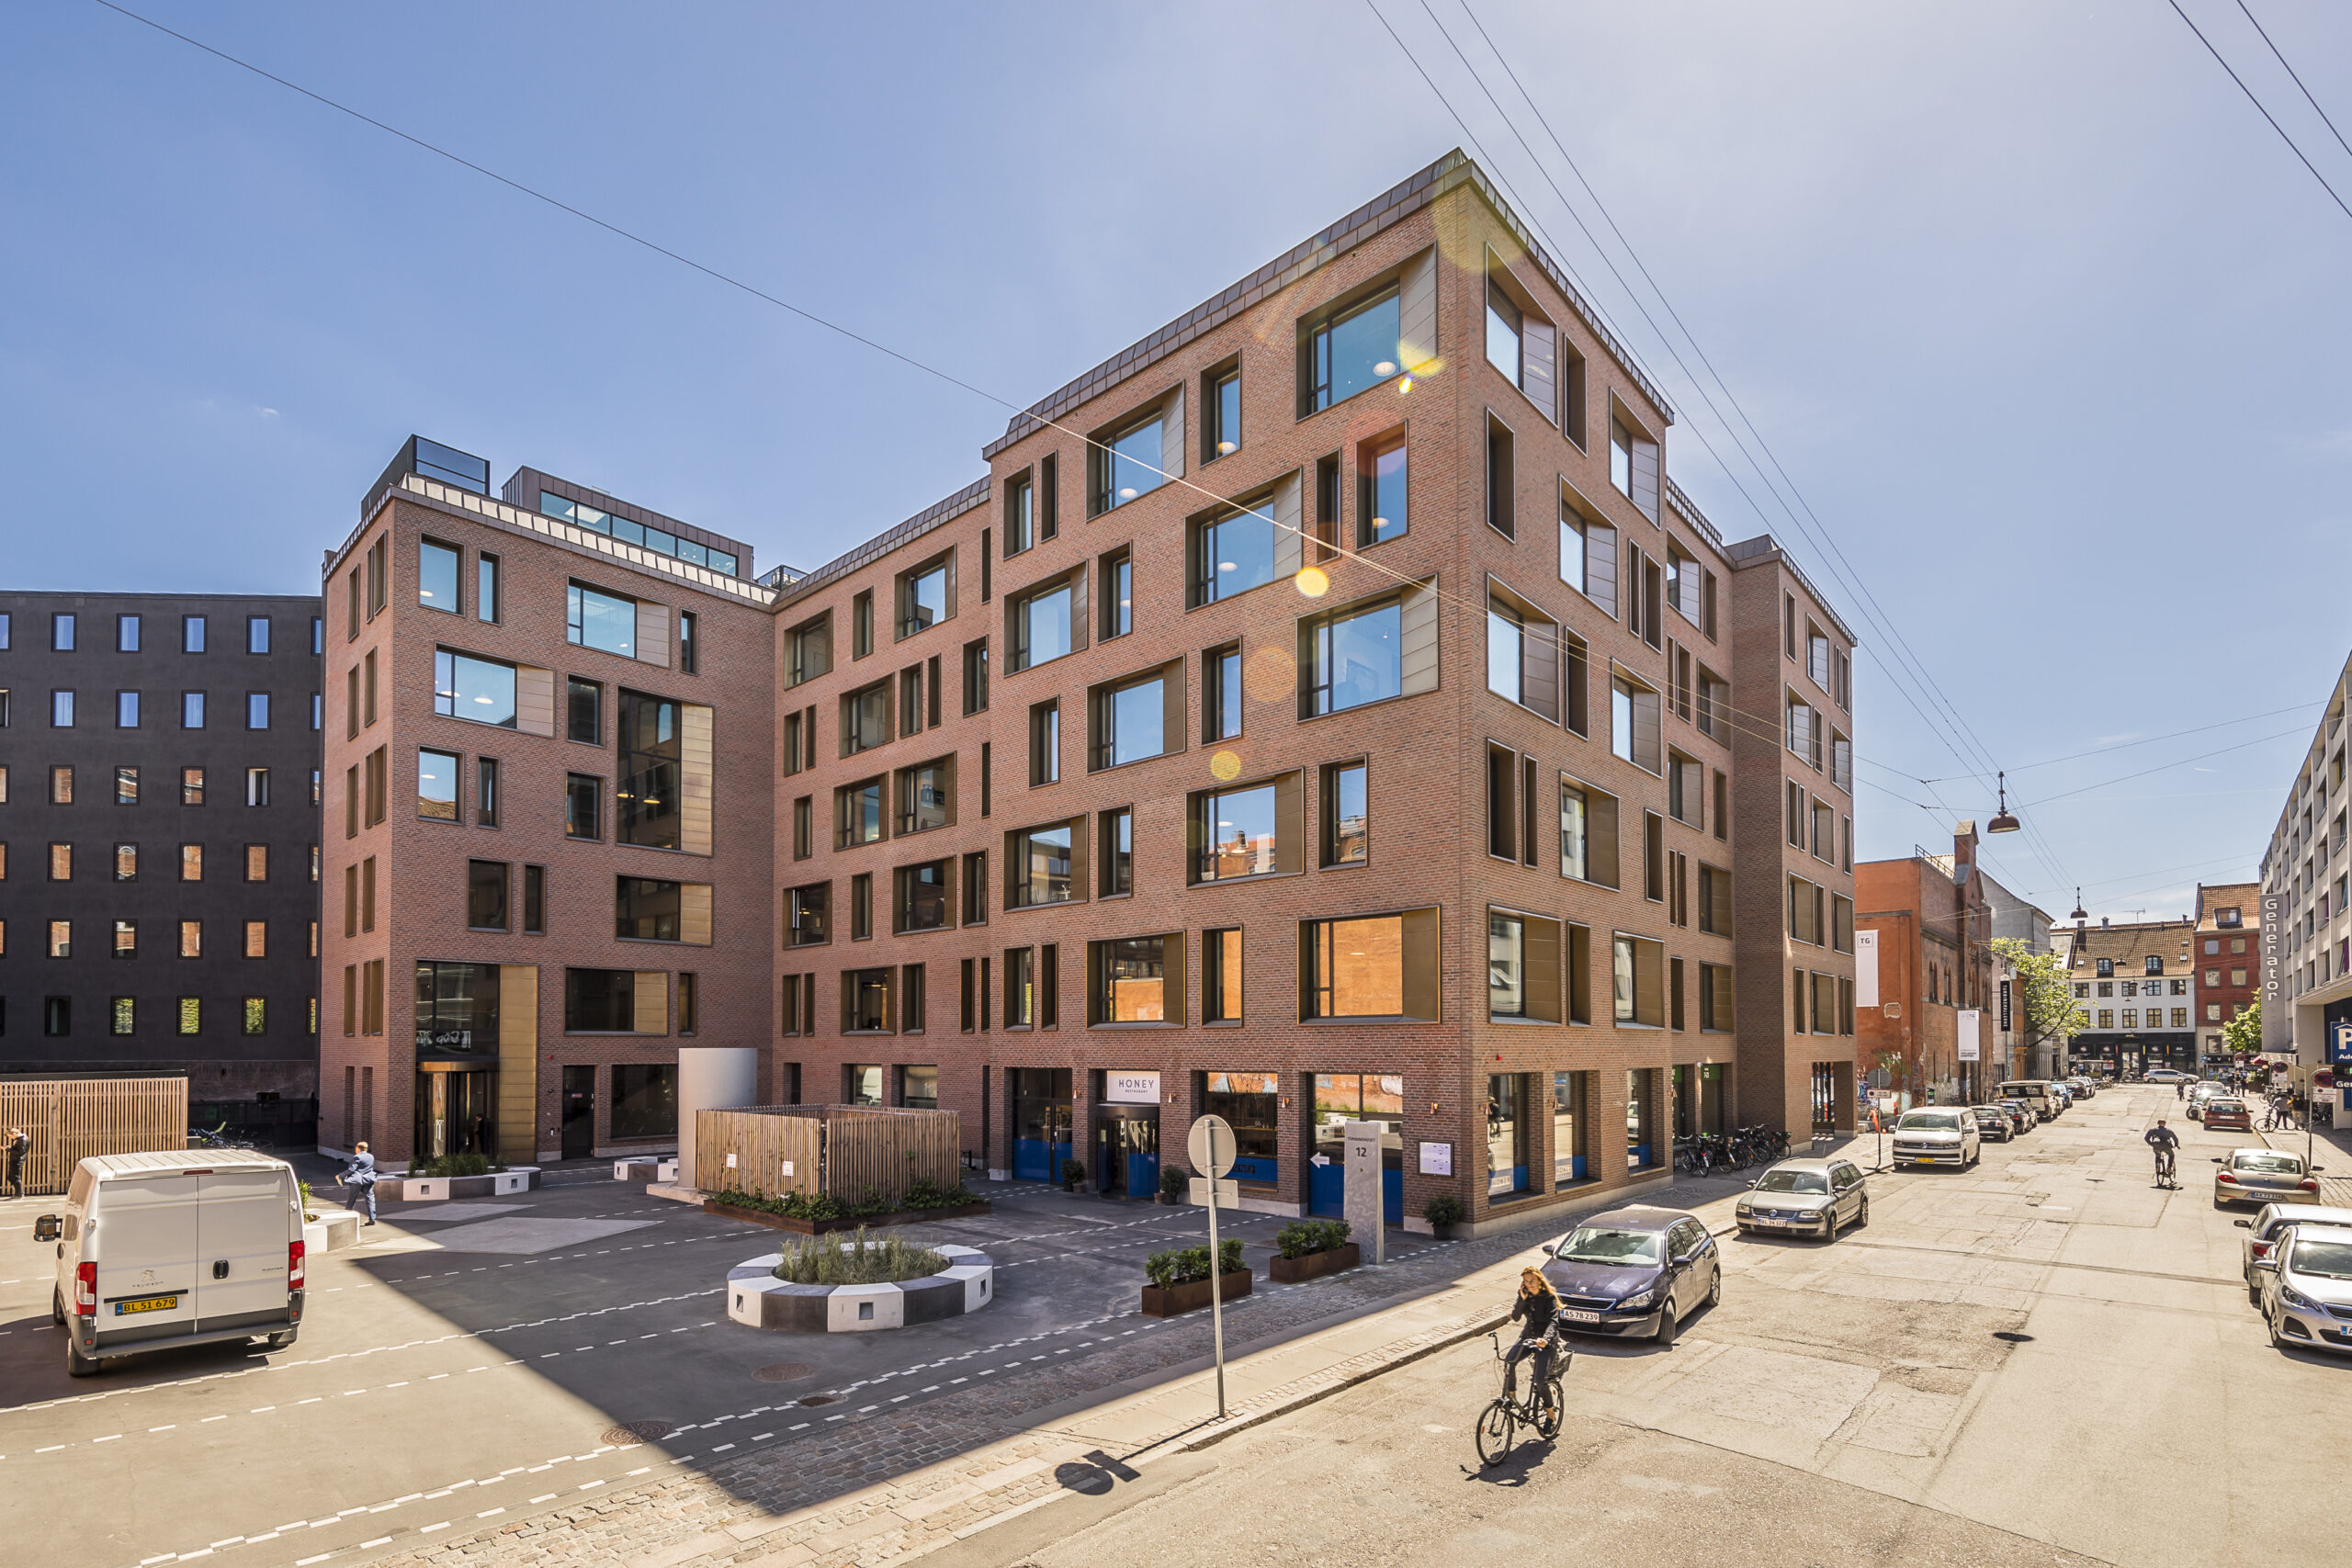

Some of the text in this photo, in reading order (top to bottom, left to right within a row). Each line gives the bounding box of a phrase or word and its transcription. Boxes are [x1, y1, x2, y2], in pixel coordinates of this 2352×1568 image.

[2265, 898, 2278, 1001] Generator
[2338, 1028, 2352, 1050] P
[1118, 1079, 1154, 1089] HONEY
[1355, 1146, 1367, 1157] 12
[123, 1298, 175, 1312] BL 51 679
[1565, 1310, 1574, 1318] AS
[1585, 1313, 1599, 1321] 239
